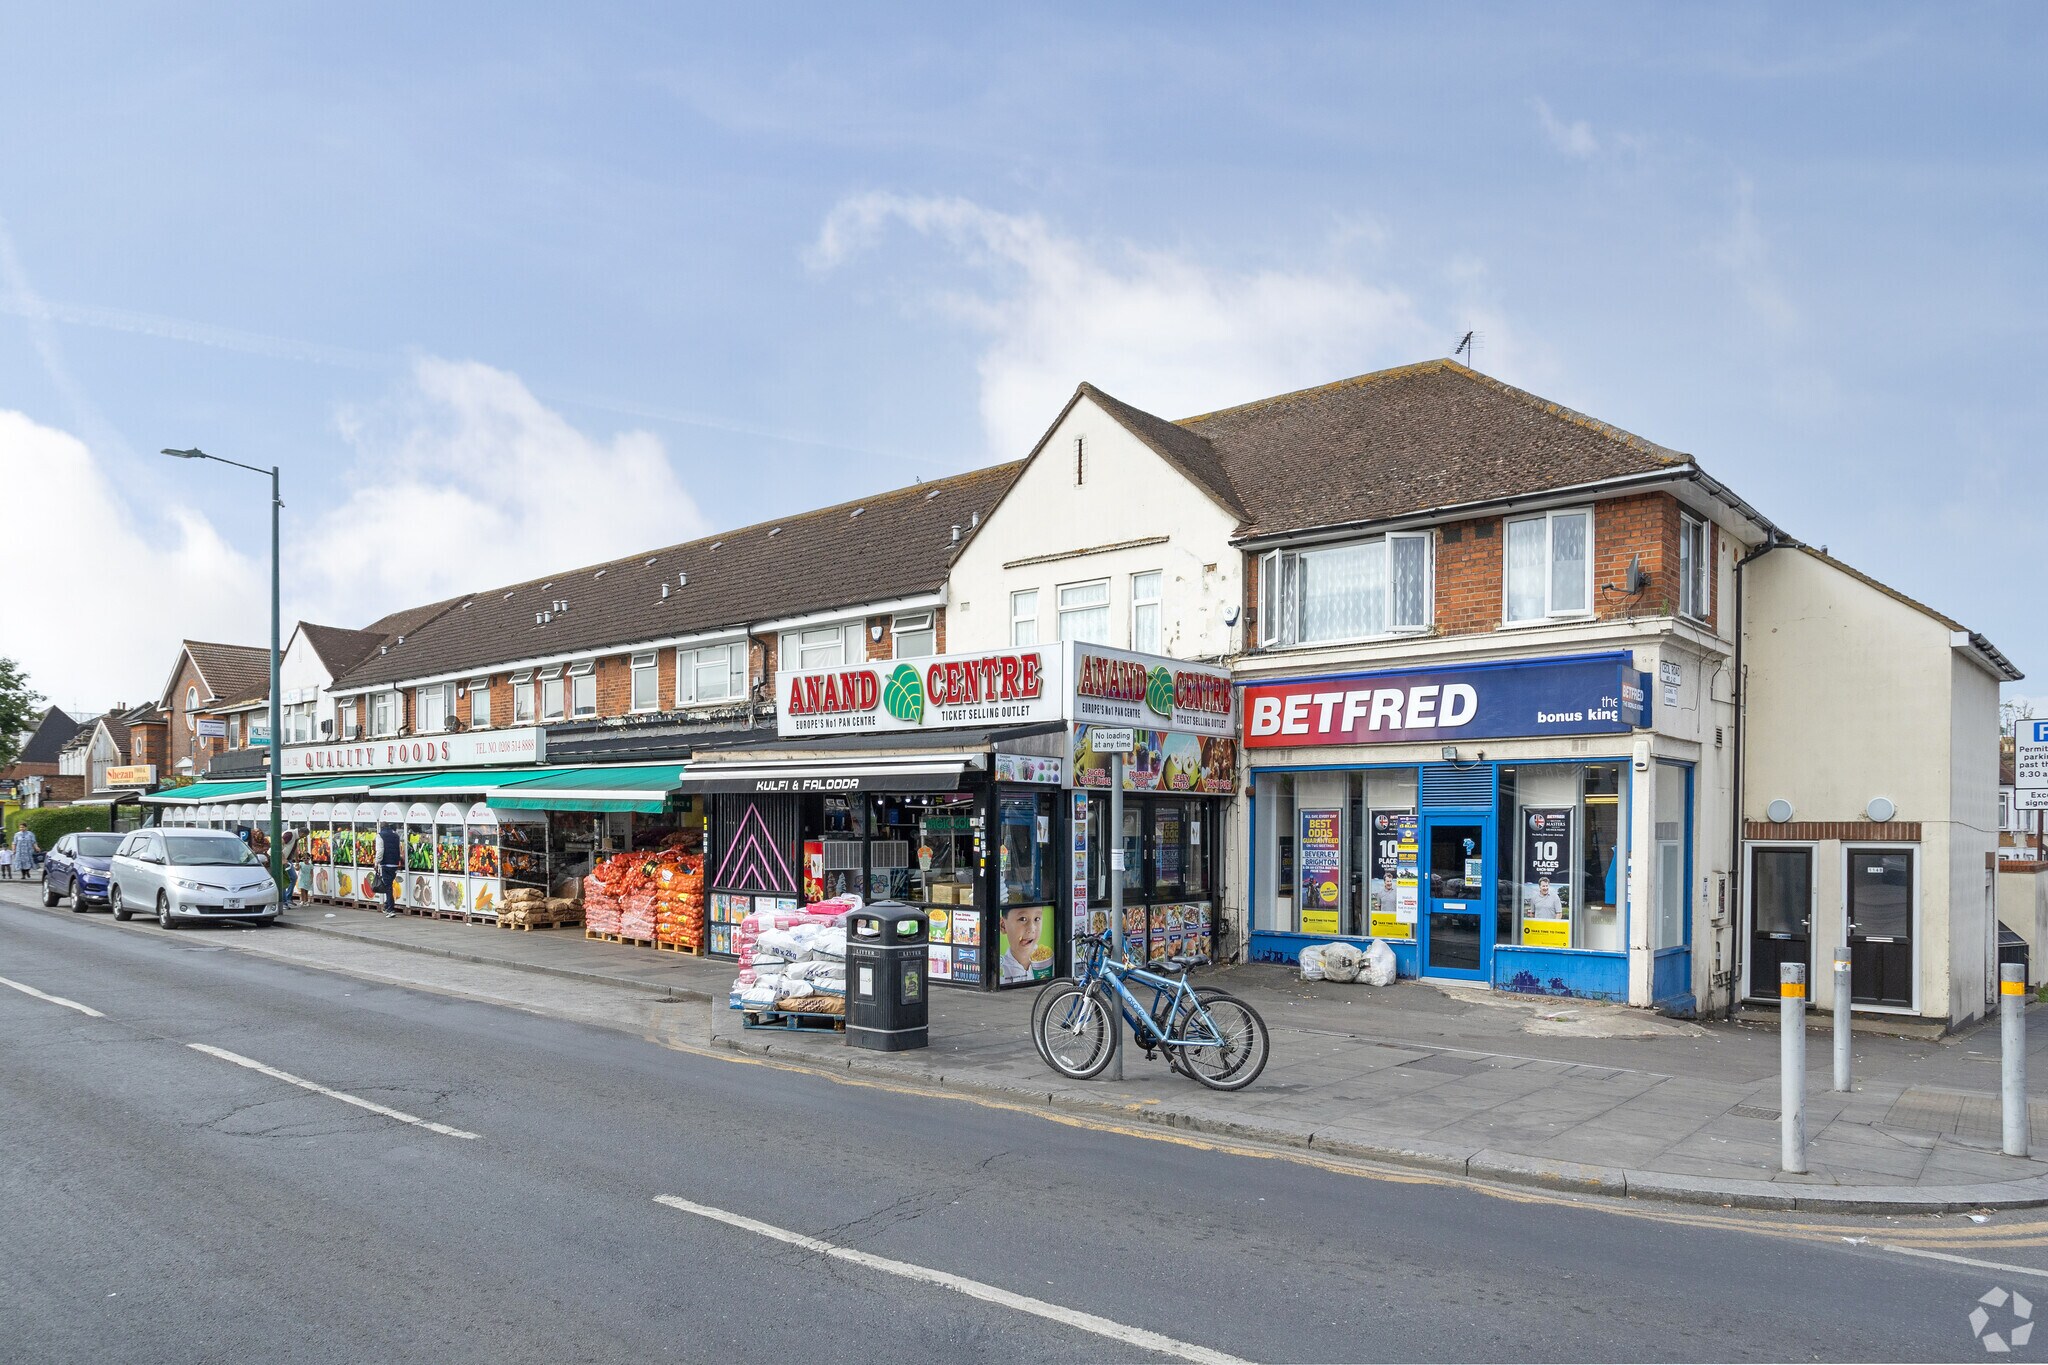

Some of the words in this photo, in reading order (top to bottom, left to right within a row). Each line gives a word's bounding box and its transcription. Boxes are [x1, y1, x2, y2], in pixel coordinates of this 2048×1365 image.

[788, 669, 881, 716] ANAND
[926, 651, 1043, 707] CENTRE
[1077, 654, 1147, 703] ANAND
[1174, 669, 1231, 715] CENTRE
[1622, 684, 1644, 702] BETFRED
[1601, 696, 1618, 708] the
[942, 709, 967, 721] TICKET
[969, 707, 999, 719] SELLING
[1001, 705, 1030, 717] OUTLET
[1082, 702, 1105, 715] EUROPE'S
[1115, 707, 1123, 717] PAN
[1124, 708, 1141, 719] CENTRE
[1250, 683, 1478, 737] BETFRED
[1537, 711, 1583, 723] bonus
[1588, 708, 1618, 722] king
[796, 719, 824, 730] EUROPE'S
[838, 717, 850, 727] PAN
[852, 715, 876, 727] CENTRE
[1176, 714, 1192, 725] TICKET
[1192, 716, 1210, 727] SELLING
[1211, 718, 1226, 729] OUTLET
[1095, 732, 1105, 740] No
[1106, 731, 1130, 742] loading
[1102, 742, 1114, 750] any
[305, 747, 374, 770] QUALITY
[387, 741, 448, 764] FOODS
[2024, 753, 2048, 761] parki
[107, 769, 133, 780] Shezan
[1087, 768, 1105, 777] SUGAR
[1129, 771, 1153, 780] FOUNTAIN
[2019, 770, 2041, 778] 8.30
[756, 780, 788, 791] KULFI
[792, 780, 799, 790] &
[802, 778, 859, 791] FALOODA
[1080, 776, 1095, 785] CANE
[1096, 776, 1111, 786] JUICE
[1172, 781, 1189, 790] NUTS
[2031, 791, 2048, 799] Exc
[1309, 819, 1332, 829] BEST
[1308, 829, 1333, 837] ODDS
[1305, 850, 1336, 858] BEVERLEY
[1380, 840, 1398, 858] 10
[1534, 841, 1558, 861] 10
[1305, 858, 1337, 866] BRIGHTON
[1532, 860, 1559, 868] PLACES
